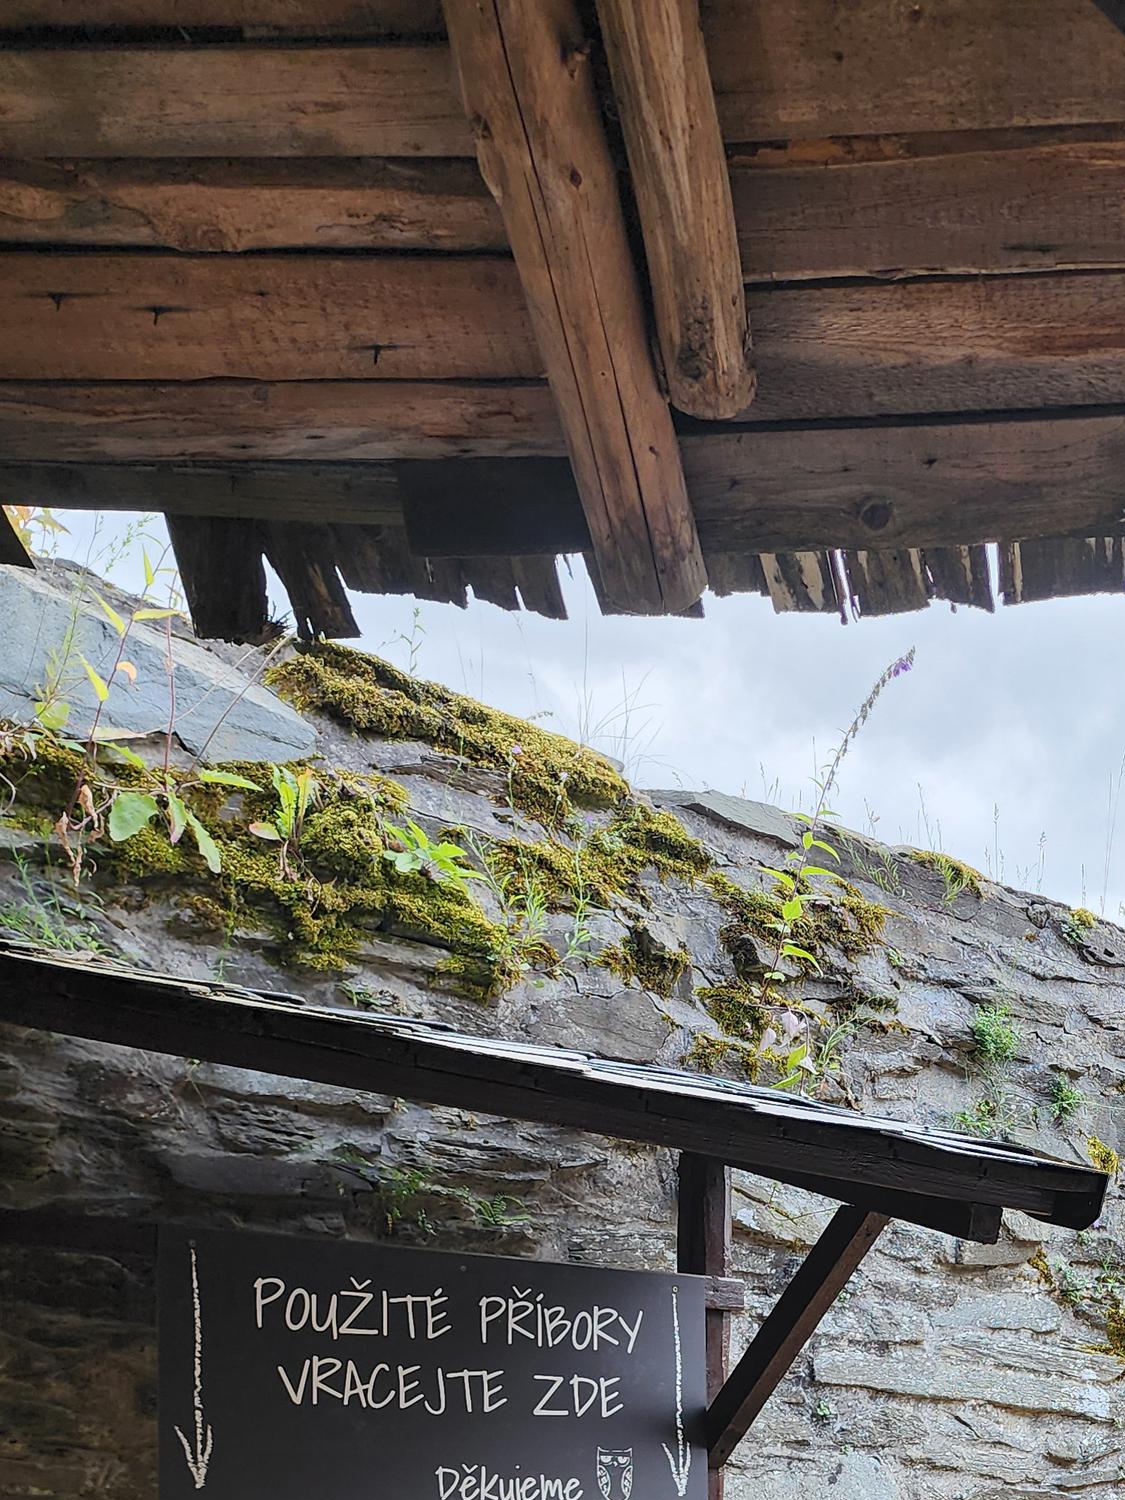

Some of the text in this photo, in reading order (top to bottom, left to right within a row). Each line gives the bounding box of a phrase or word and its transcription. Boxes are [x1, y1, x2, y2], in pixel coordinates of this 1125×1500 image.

[253, 1276, 644, 1355] POUŽITÉ PŘÍBORY
[277, 1355, 624, 1418] VRACEJTE ZDE
